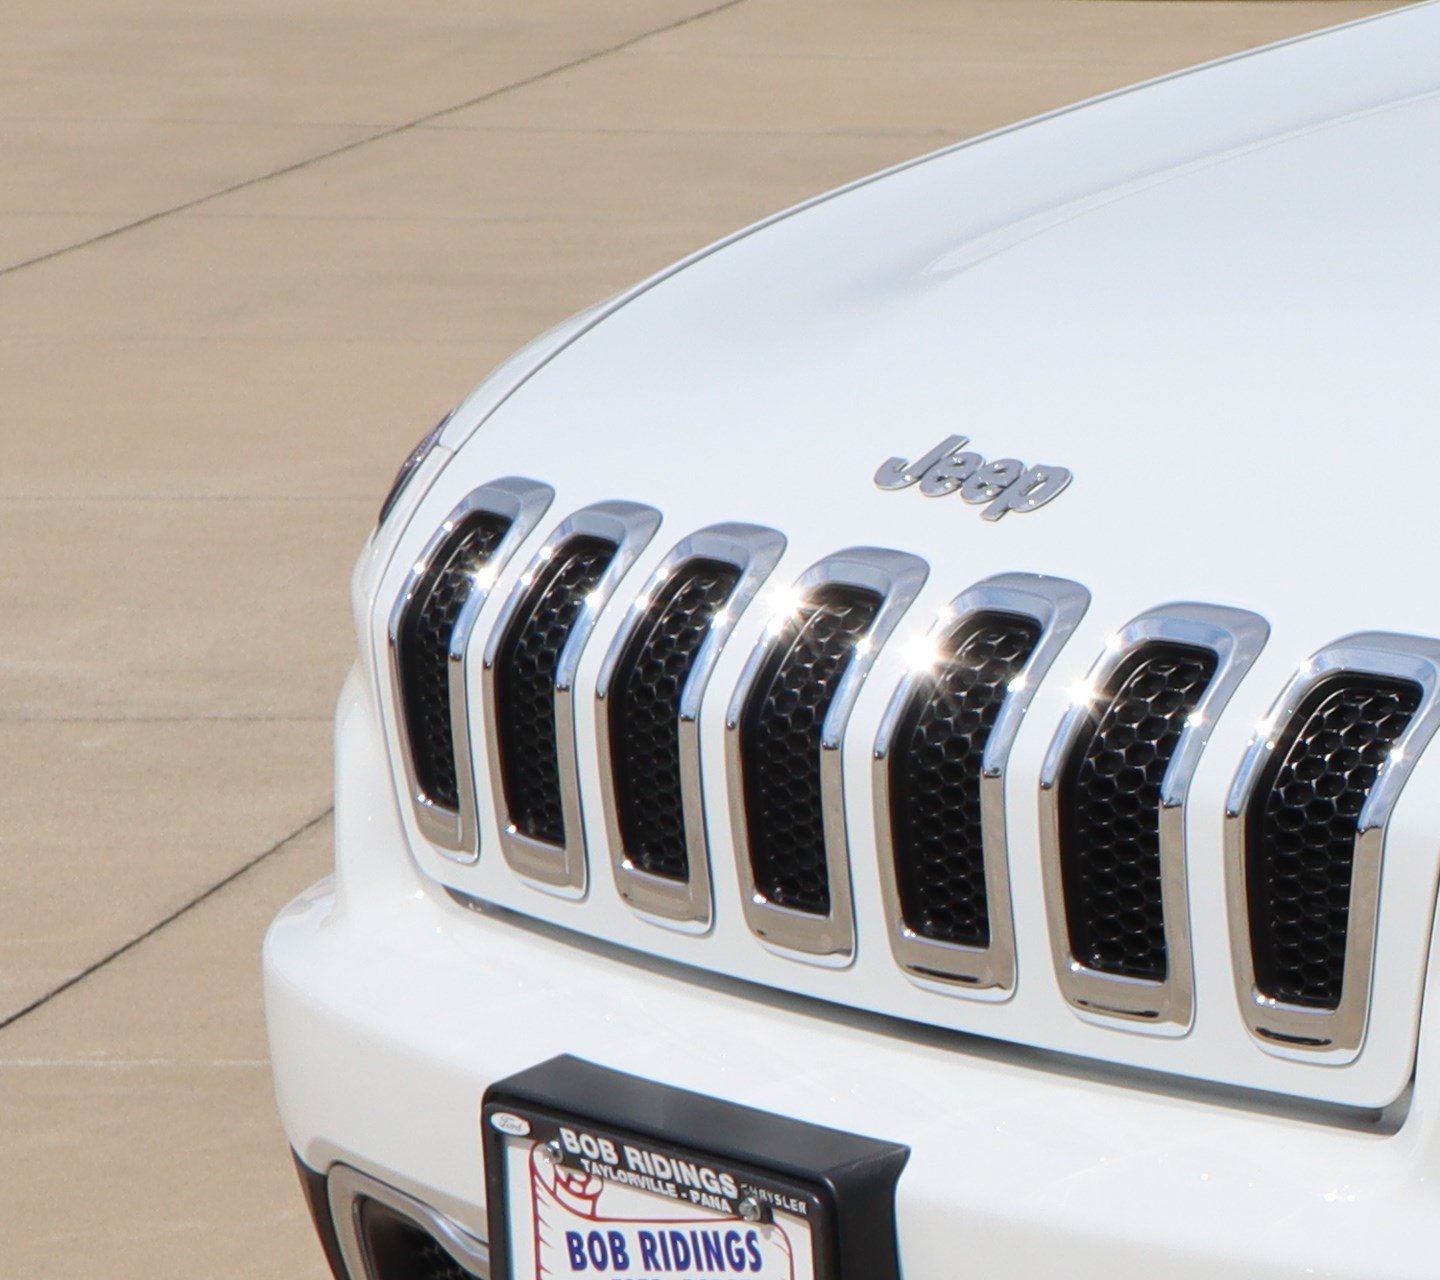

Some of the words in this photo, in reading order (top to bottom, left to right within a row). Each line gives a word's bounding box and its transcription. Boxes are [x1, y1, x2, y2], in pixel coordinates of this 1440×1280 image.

[873, 433, 1074, 522] Jeep
[559, 1126, 619, 1166] BOB
[623, 1145, 738, 1200] RIDINGS
[580, 1158, 678, 1199] TAYLORVILLE
[689, 1189, 732, 1214] PANA
[565, 1229, 631, 1272] BOB
[637, 1229, 763, 1273] RIDINGS
